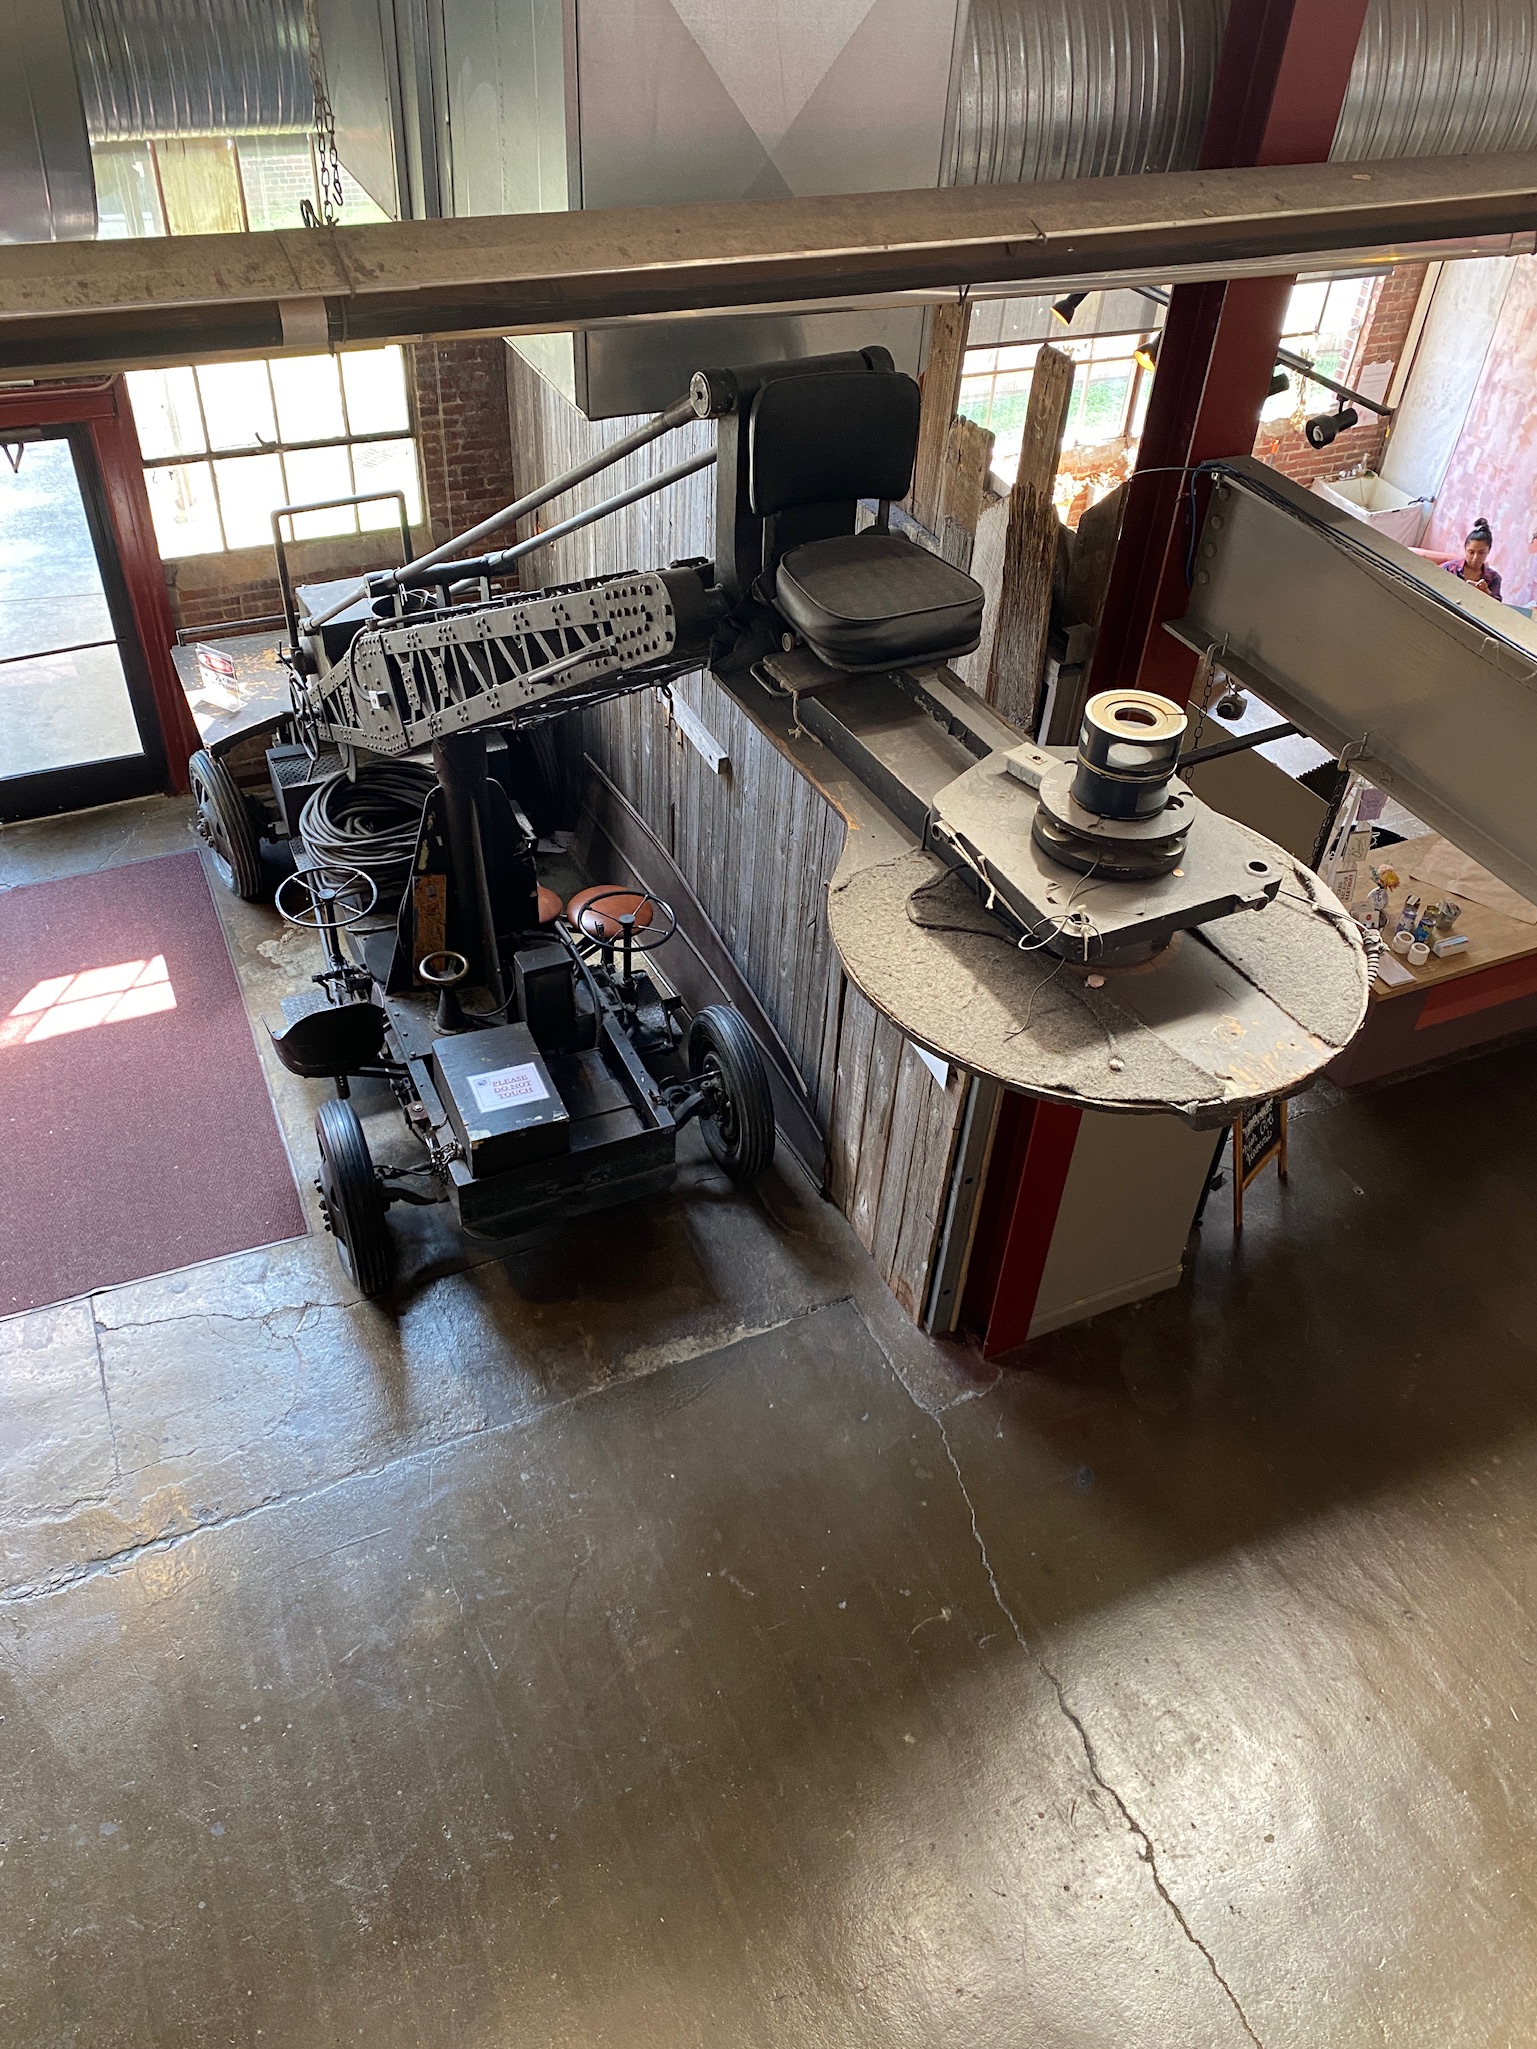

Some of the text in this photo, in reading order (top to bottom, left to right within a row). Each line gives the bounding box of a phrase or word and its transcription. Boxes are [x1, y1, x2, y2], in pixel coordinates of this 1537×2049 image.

[492, 1075, 528, 1087] PLEASE
[511, 1080, 532, 1089] NOT
[497, 1087, 534, 1099] TOUCH
